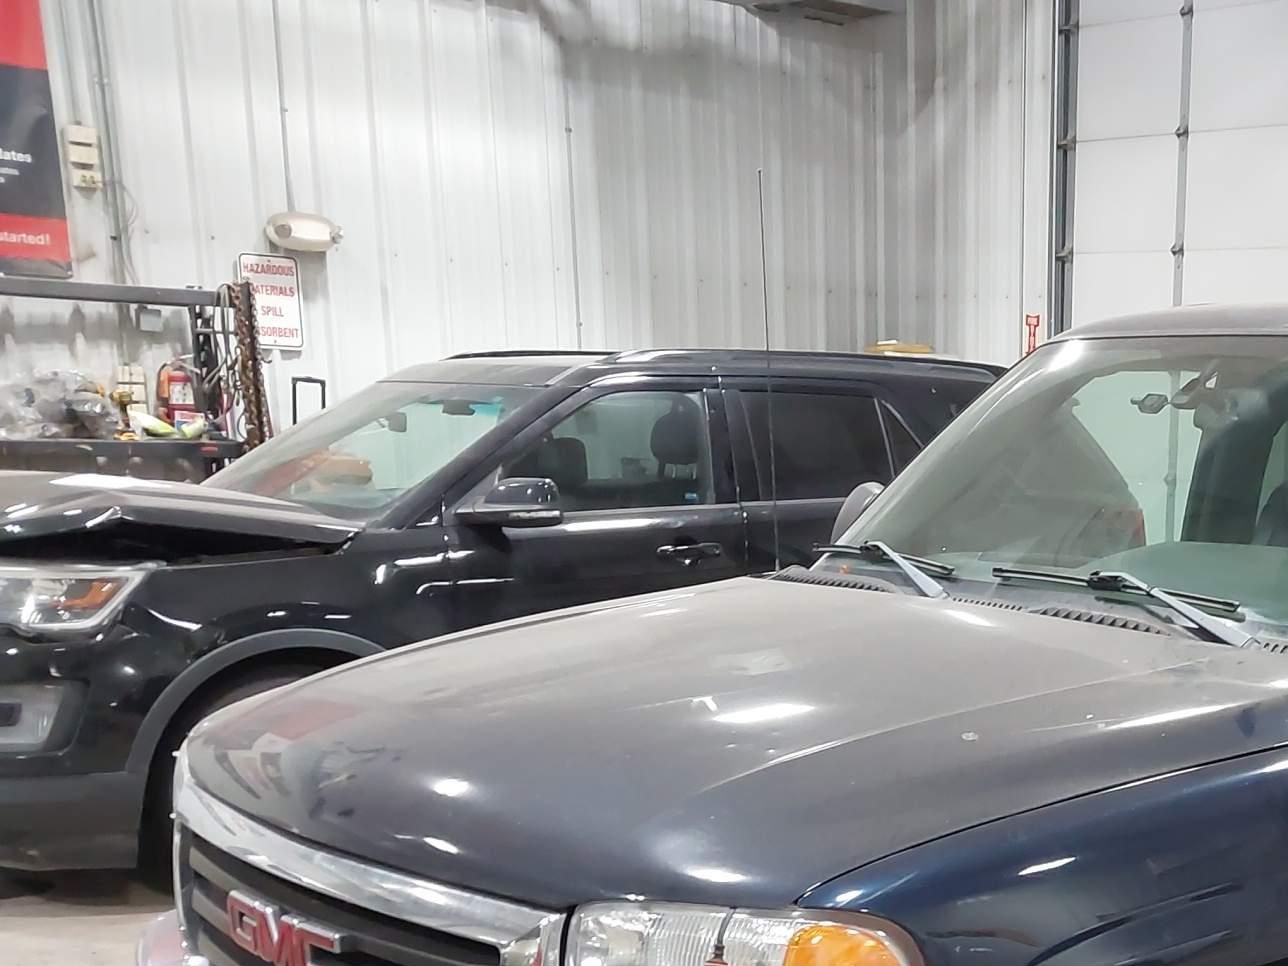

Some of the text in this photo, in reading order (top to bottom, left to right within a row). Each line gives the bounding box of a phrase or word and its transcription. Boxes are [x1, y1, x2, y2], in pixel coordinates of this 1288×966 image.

[242, 263, 295, 277] HAZARDOUS
[253, 284, 295, 297] ATERIALS
[261, 305, 284, 317] SPILL
